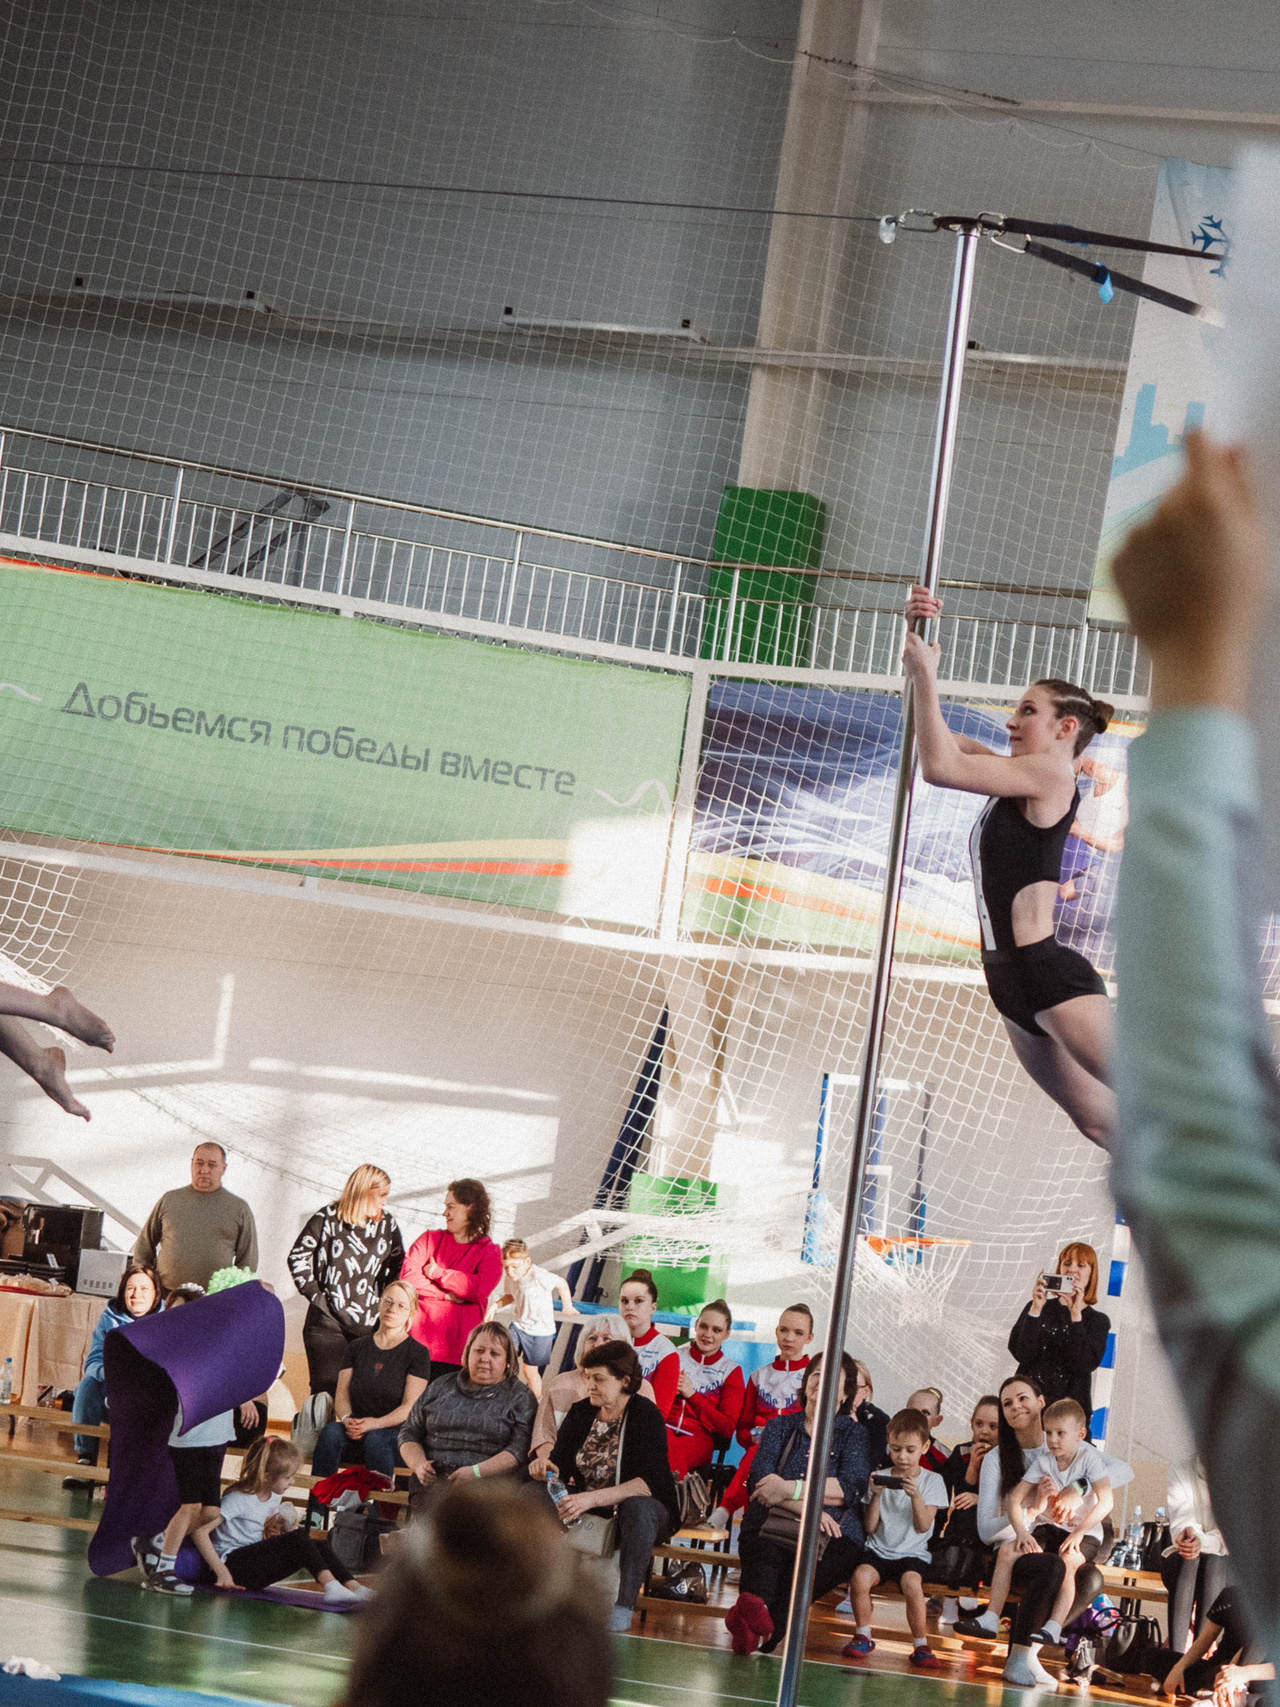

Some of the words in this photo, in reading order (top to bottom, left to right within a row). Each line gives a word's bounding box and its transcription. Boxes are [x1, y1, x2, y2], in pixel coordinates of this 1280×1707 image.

[60, 681, 272, 747] Добьемся
[281, 725, 429, 773] победы
[440, 750, 577, 797] вместе
